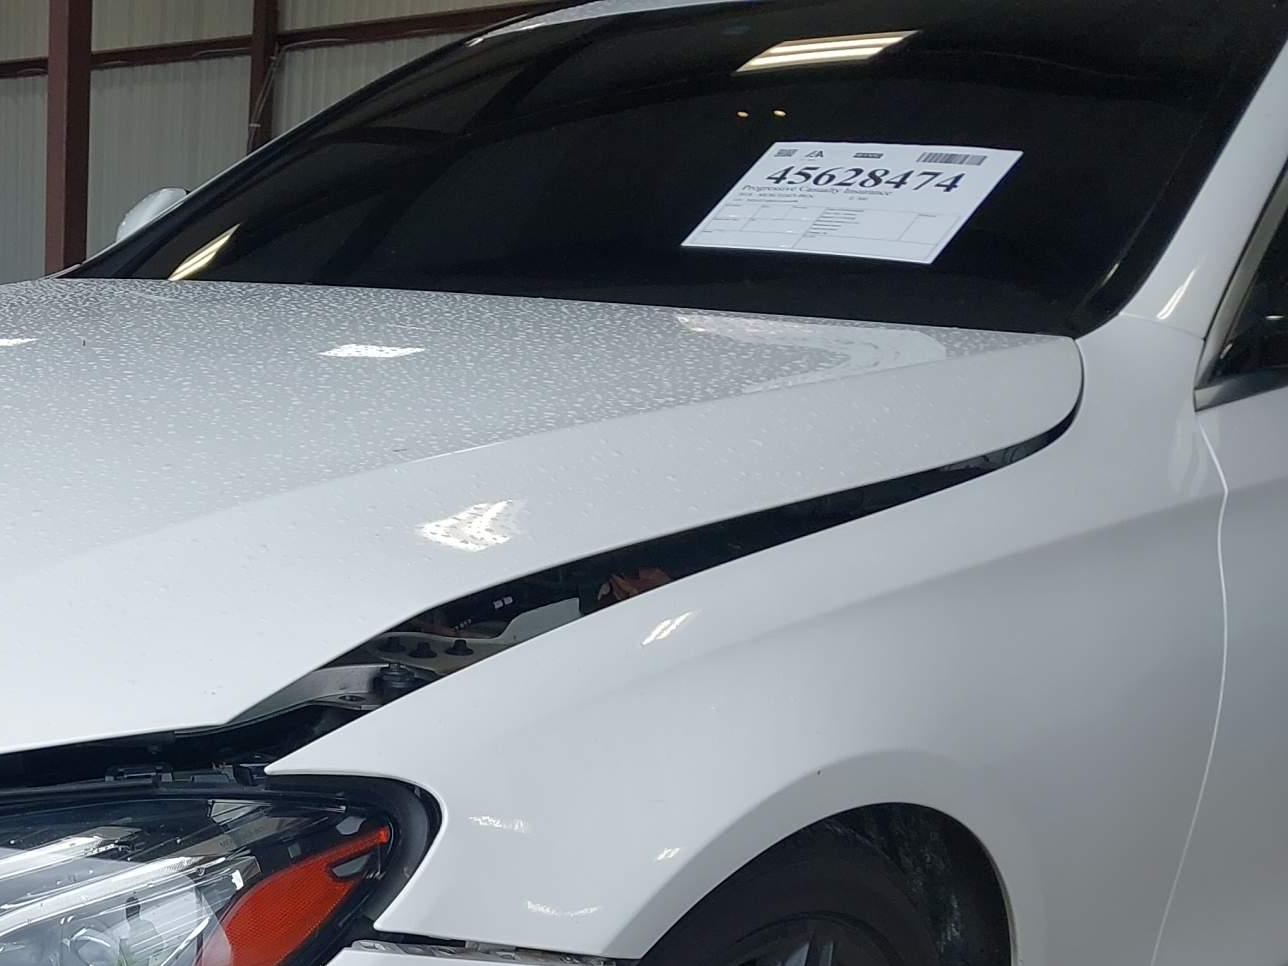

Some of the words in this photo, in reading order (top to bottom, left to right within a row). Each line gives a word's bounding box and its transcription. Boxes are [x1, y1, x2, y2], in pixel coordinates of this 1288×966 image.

[766, 165, 965, 193] 45628474
[742, 184, 797, 194] Progressive
[843, 187, 893, 196] Insurance
